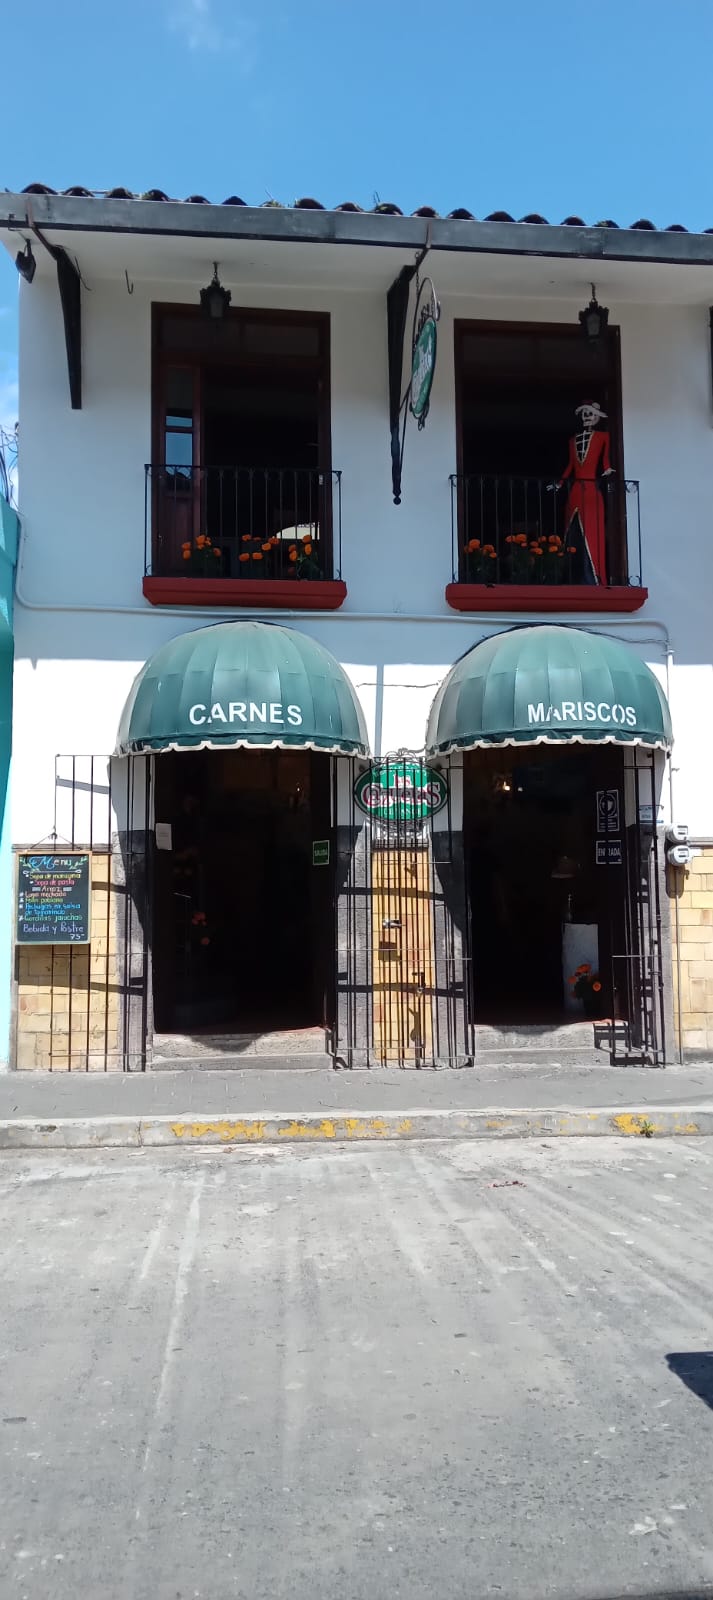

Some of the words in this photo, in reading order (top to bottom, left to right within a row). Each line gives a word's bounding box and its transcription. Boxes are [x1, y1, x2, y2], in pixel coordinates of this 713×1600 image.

[189, 702, 303, 725] CARNES
[527, 701, 637, 726] MARISCOS
[29, 856, 72, 870] Menu
[23, 923, 50, 933] Bebida
[52, 926, 58, 935] y
[60, 921, 84, 933] Postre
